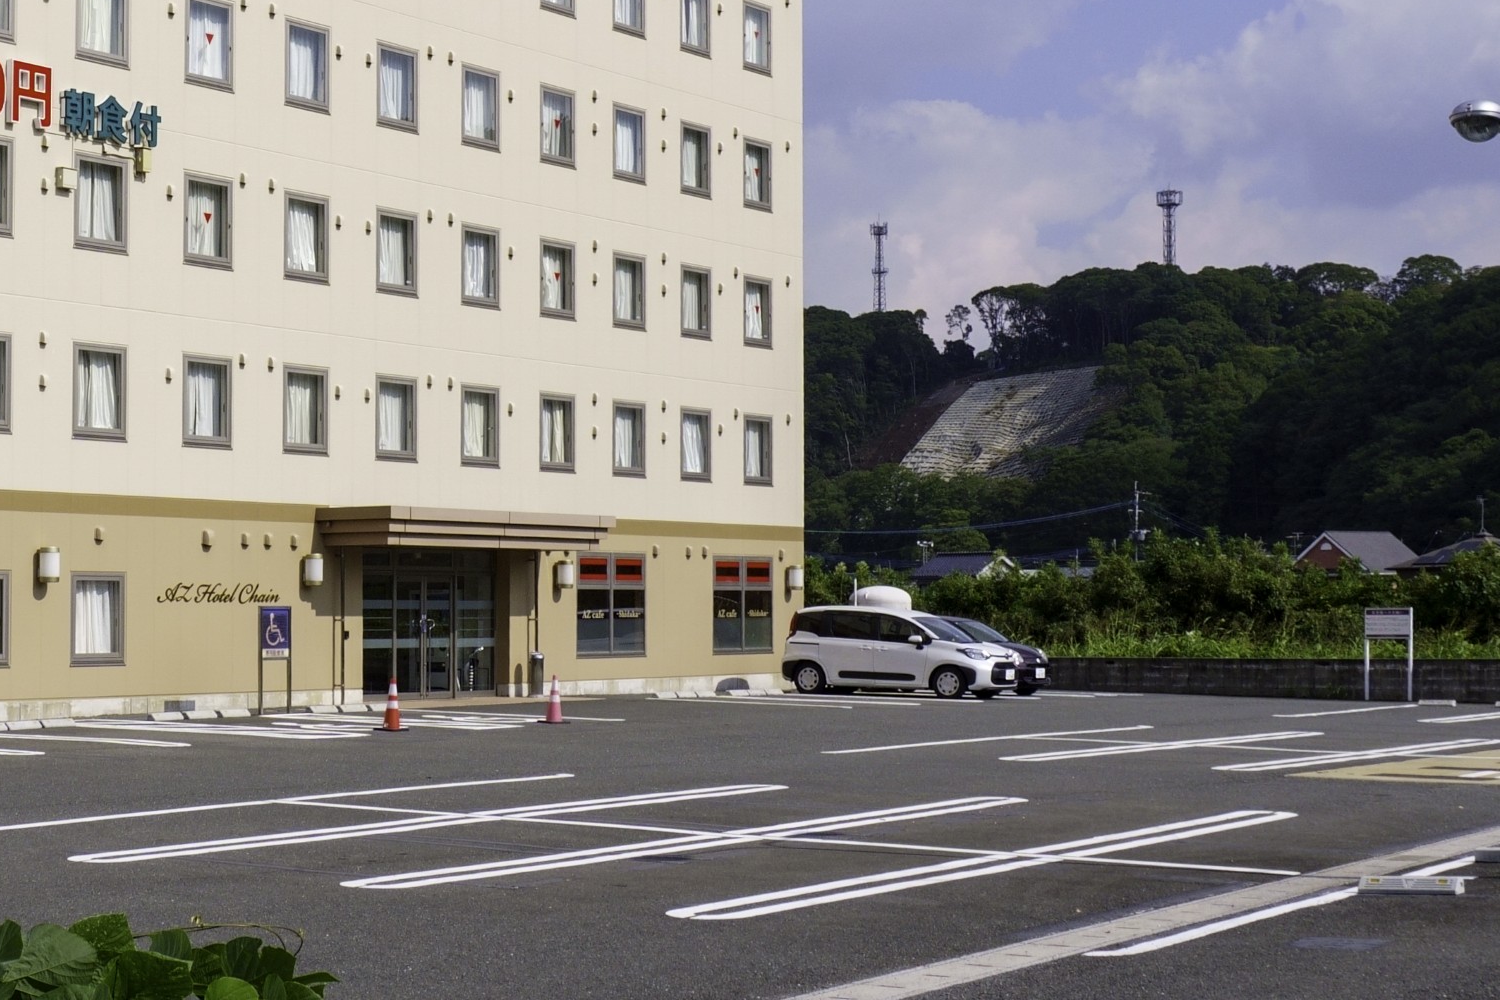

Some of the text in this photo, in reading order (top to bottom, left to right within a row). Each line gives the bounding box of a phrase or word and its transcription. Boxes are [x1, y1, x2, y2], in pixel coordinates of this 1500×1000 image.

[61, 89, 161, 148] 朝食付
[157, 583, 280, 604] AZ Hotel Chain
[582, 610, 591, 618] AZ
